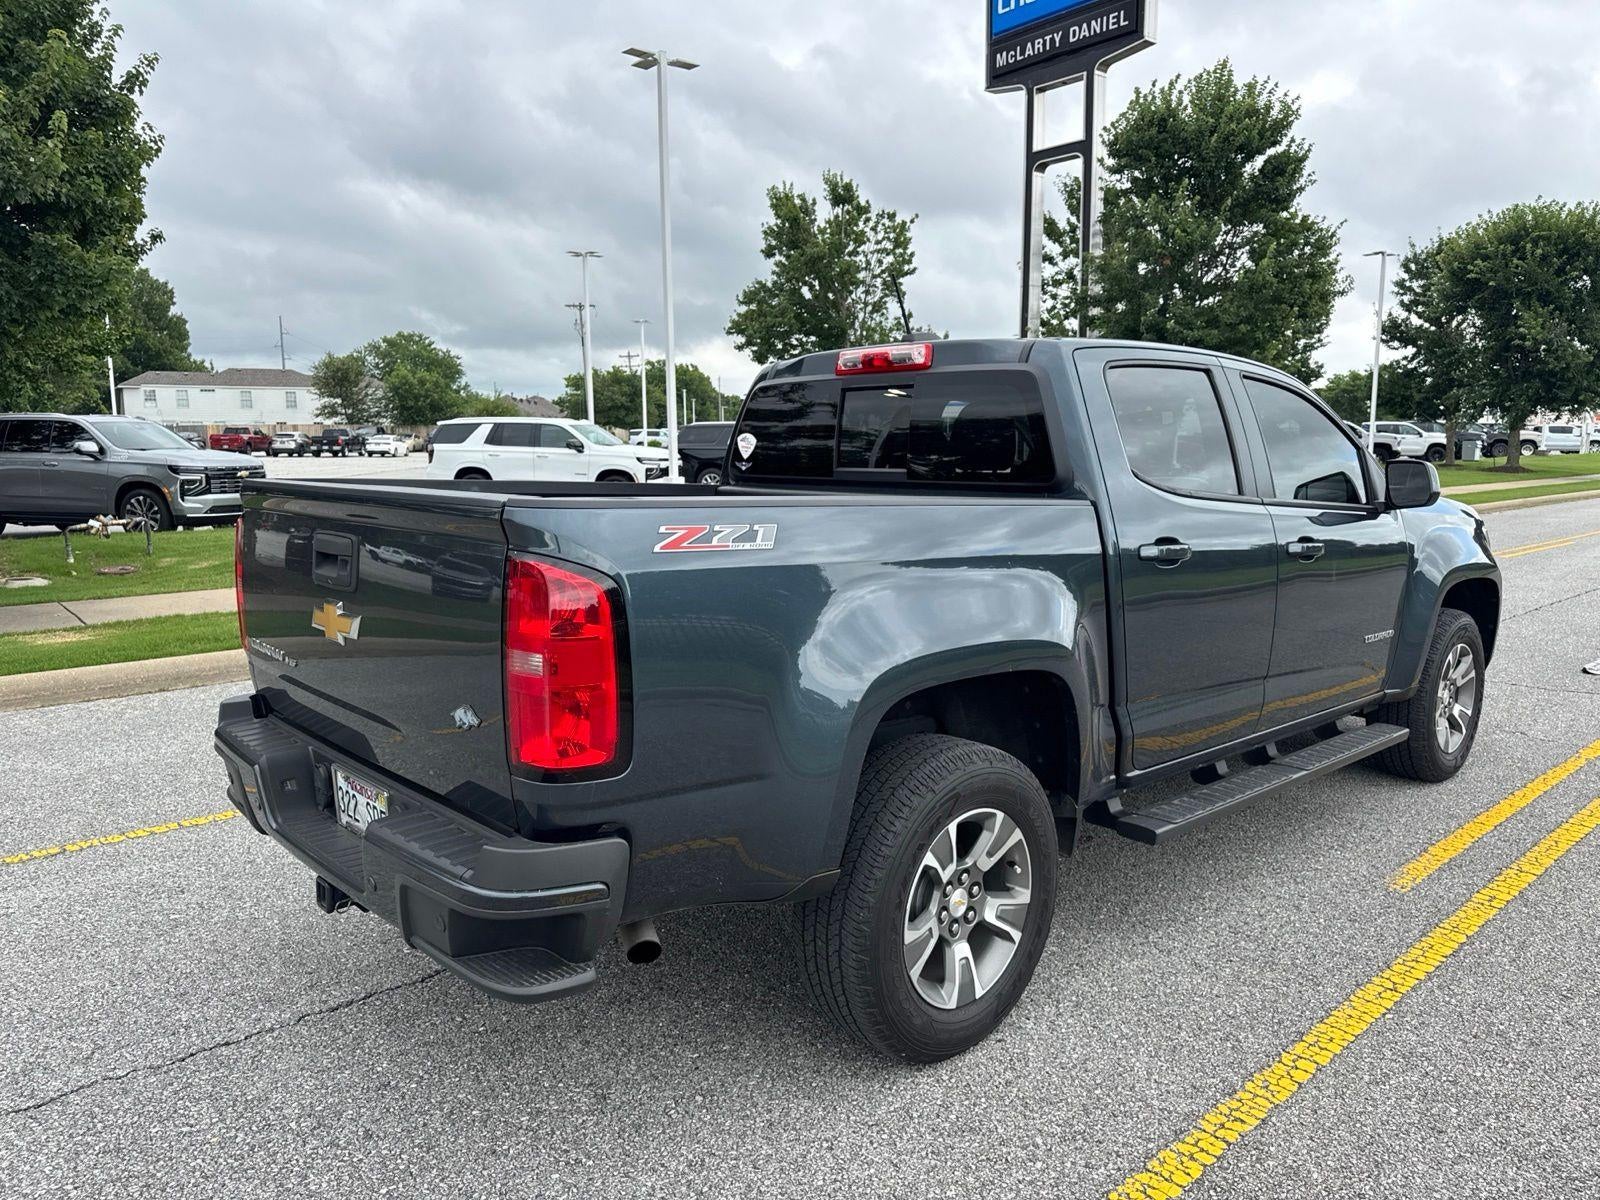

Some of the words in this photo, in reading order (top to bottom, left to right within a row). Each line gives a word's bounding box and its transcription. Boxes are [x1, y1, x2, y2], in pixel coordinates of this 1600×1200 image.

[996, 31, 1063, 68] McLARTY
[1069, 10, 1129, 43] DANIEL
[653, 523, 778, 553] Z71
[338, 786, 360, 822] 322
